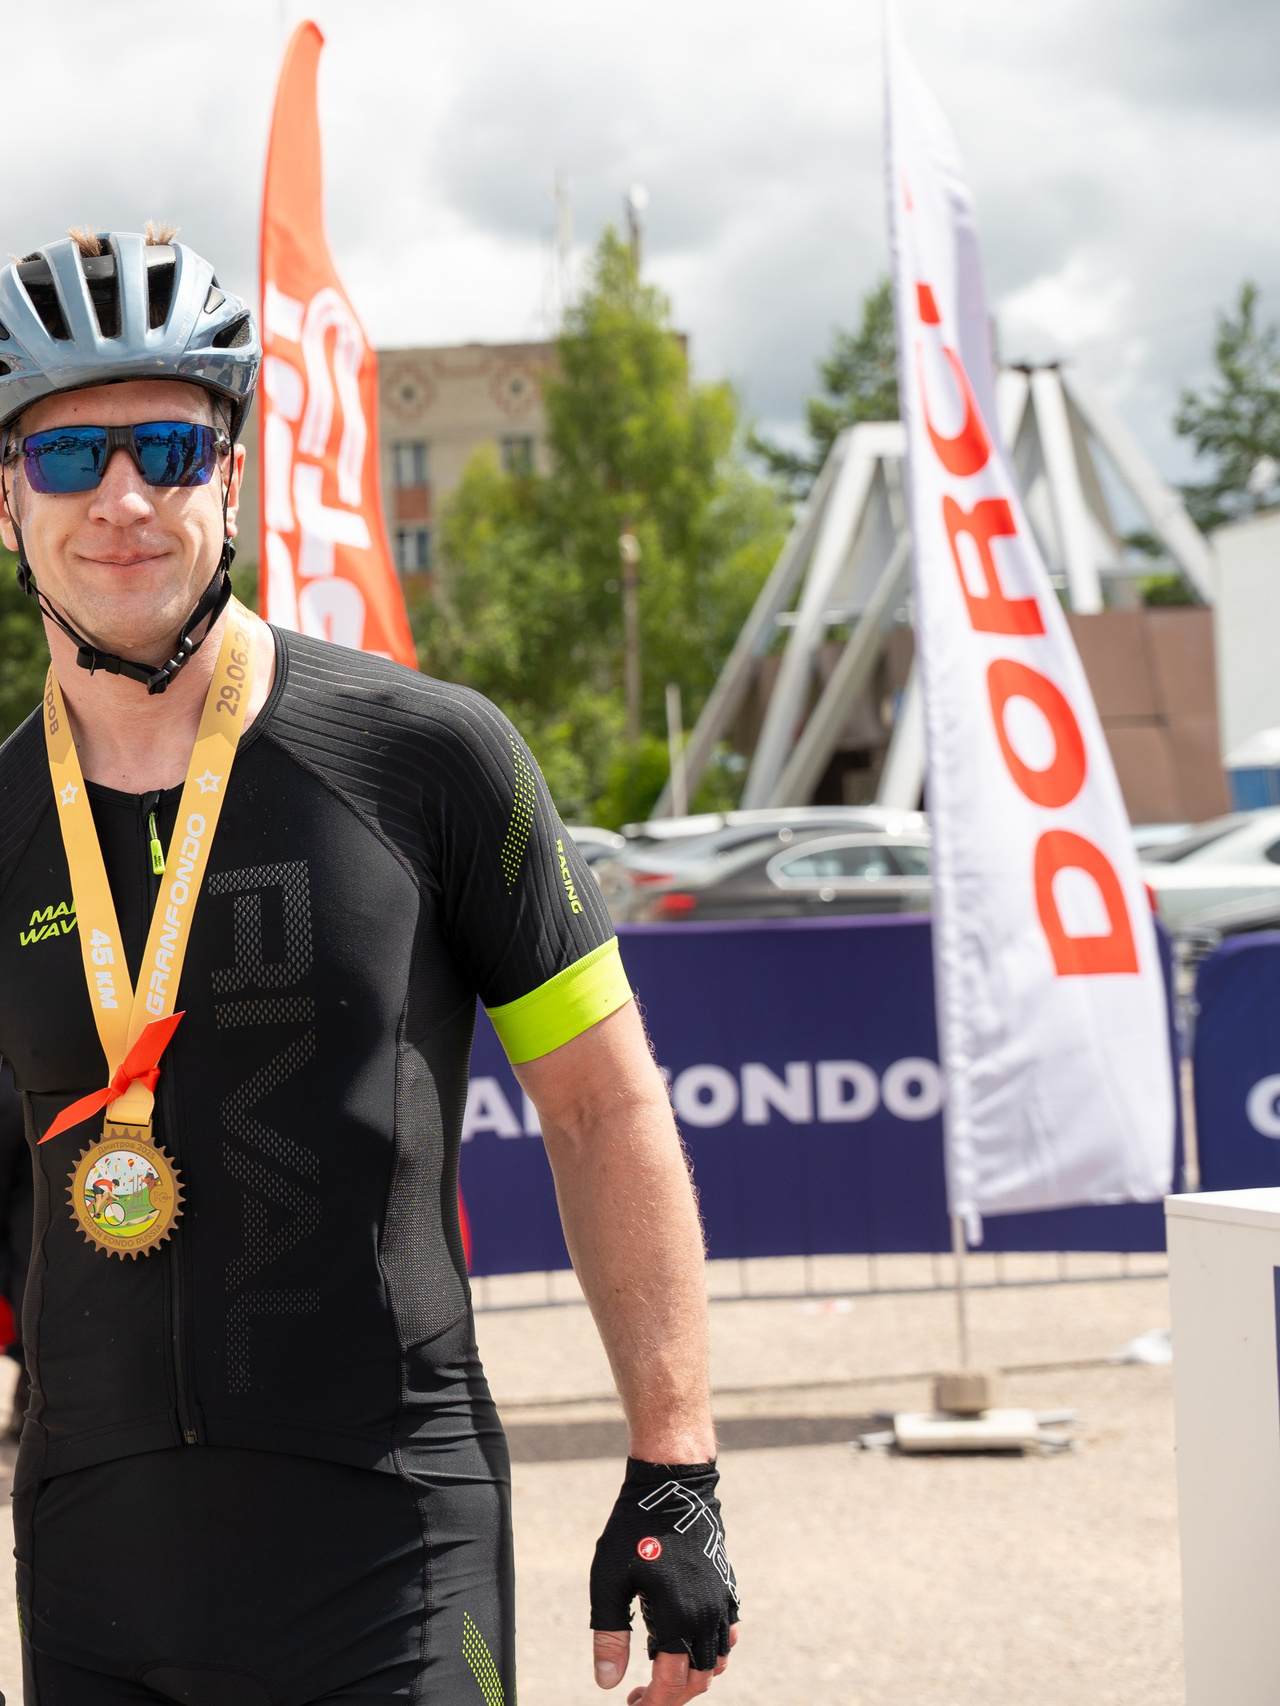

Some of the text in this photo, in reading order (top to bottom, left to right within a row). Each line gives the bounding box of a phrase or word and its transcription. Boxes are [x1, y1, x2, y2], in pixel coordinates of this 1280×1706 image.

[556, 839, 583, 915] RACING
[19, 916, 78, 946] WAV
[146, 813, 206, 1016] GRANFONDO
[90, 929, 119, 1009] 45 KM
[98, 1141, 156, 1160] Дмитров 2025
[83, 1216, 163, 1247] GRAN FONDO RUSSIA
